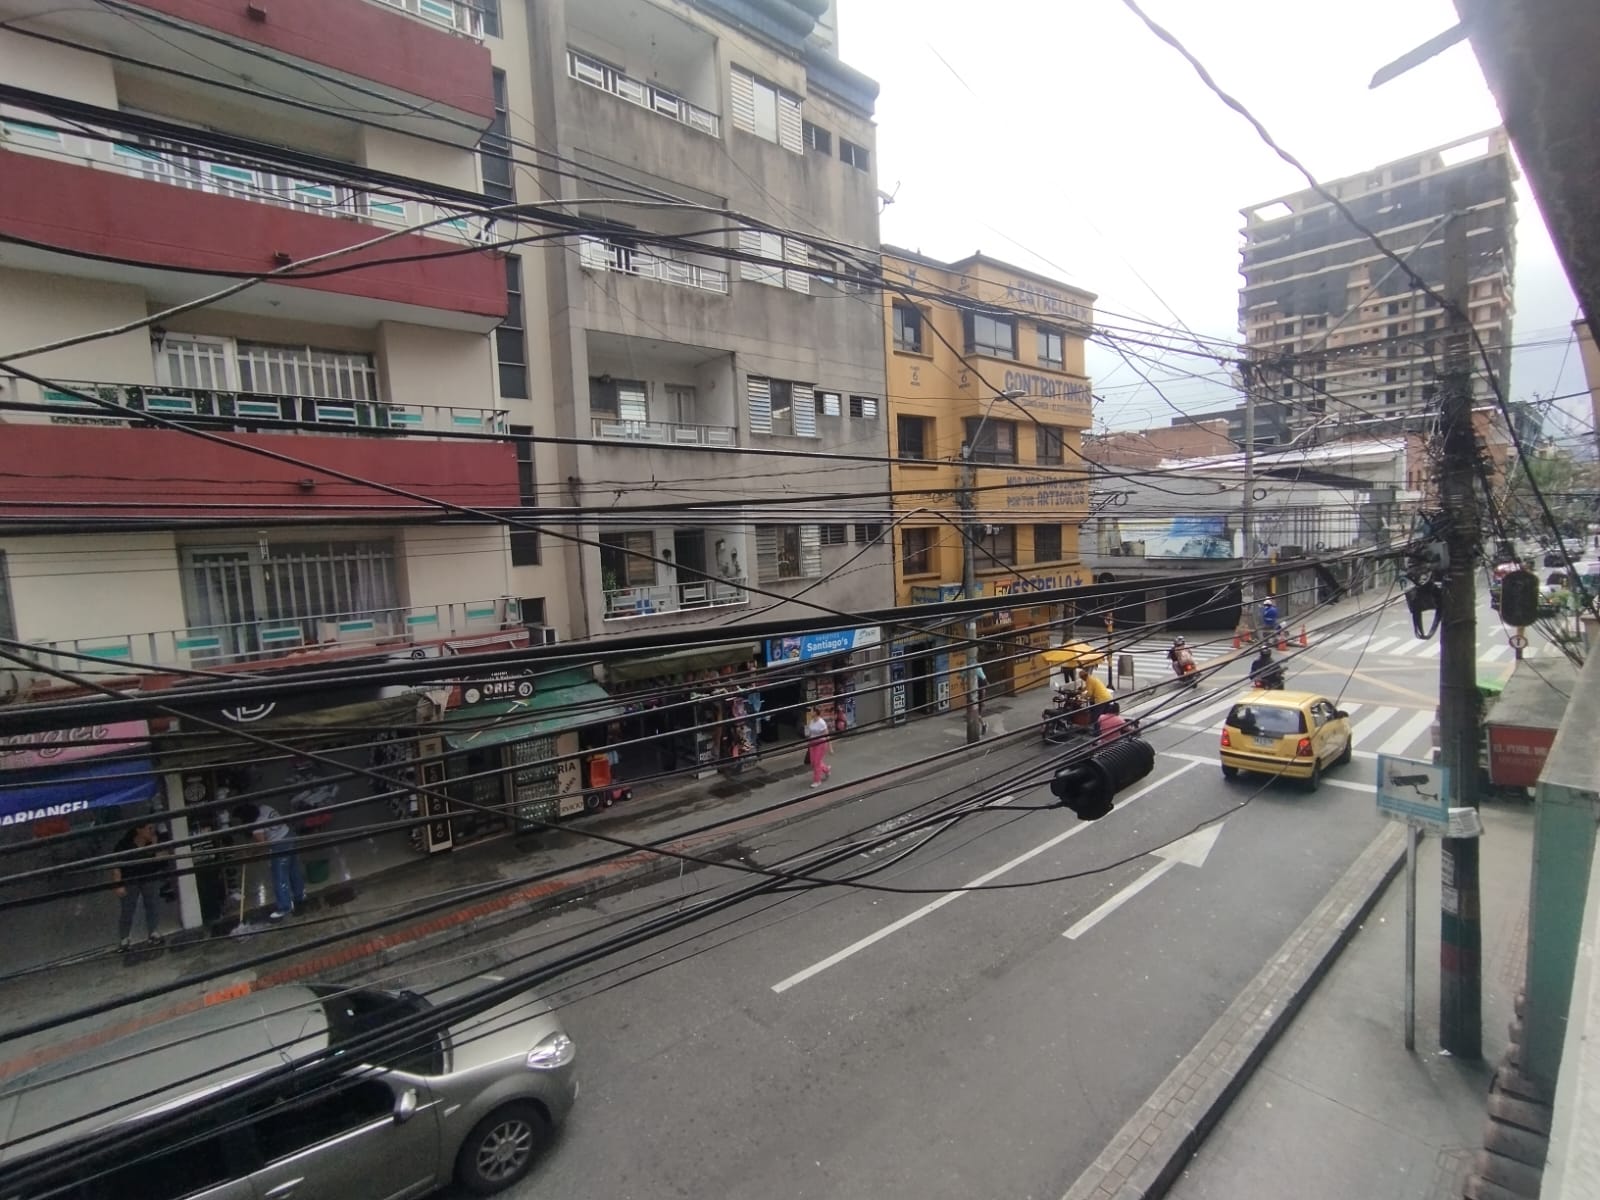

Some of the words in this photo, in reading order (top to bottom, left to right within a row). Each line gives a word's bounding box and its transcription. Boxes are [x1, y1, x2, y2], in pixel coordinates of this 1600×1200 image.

[1005, 370, 1092, 403] CONTRATAMOS
[1037, 490, 1085, 507] ARTICULOS
[807, 638, 848, 652] Santiago's
[483, 681, 516, 695] ORIS
